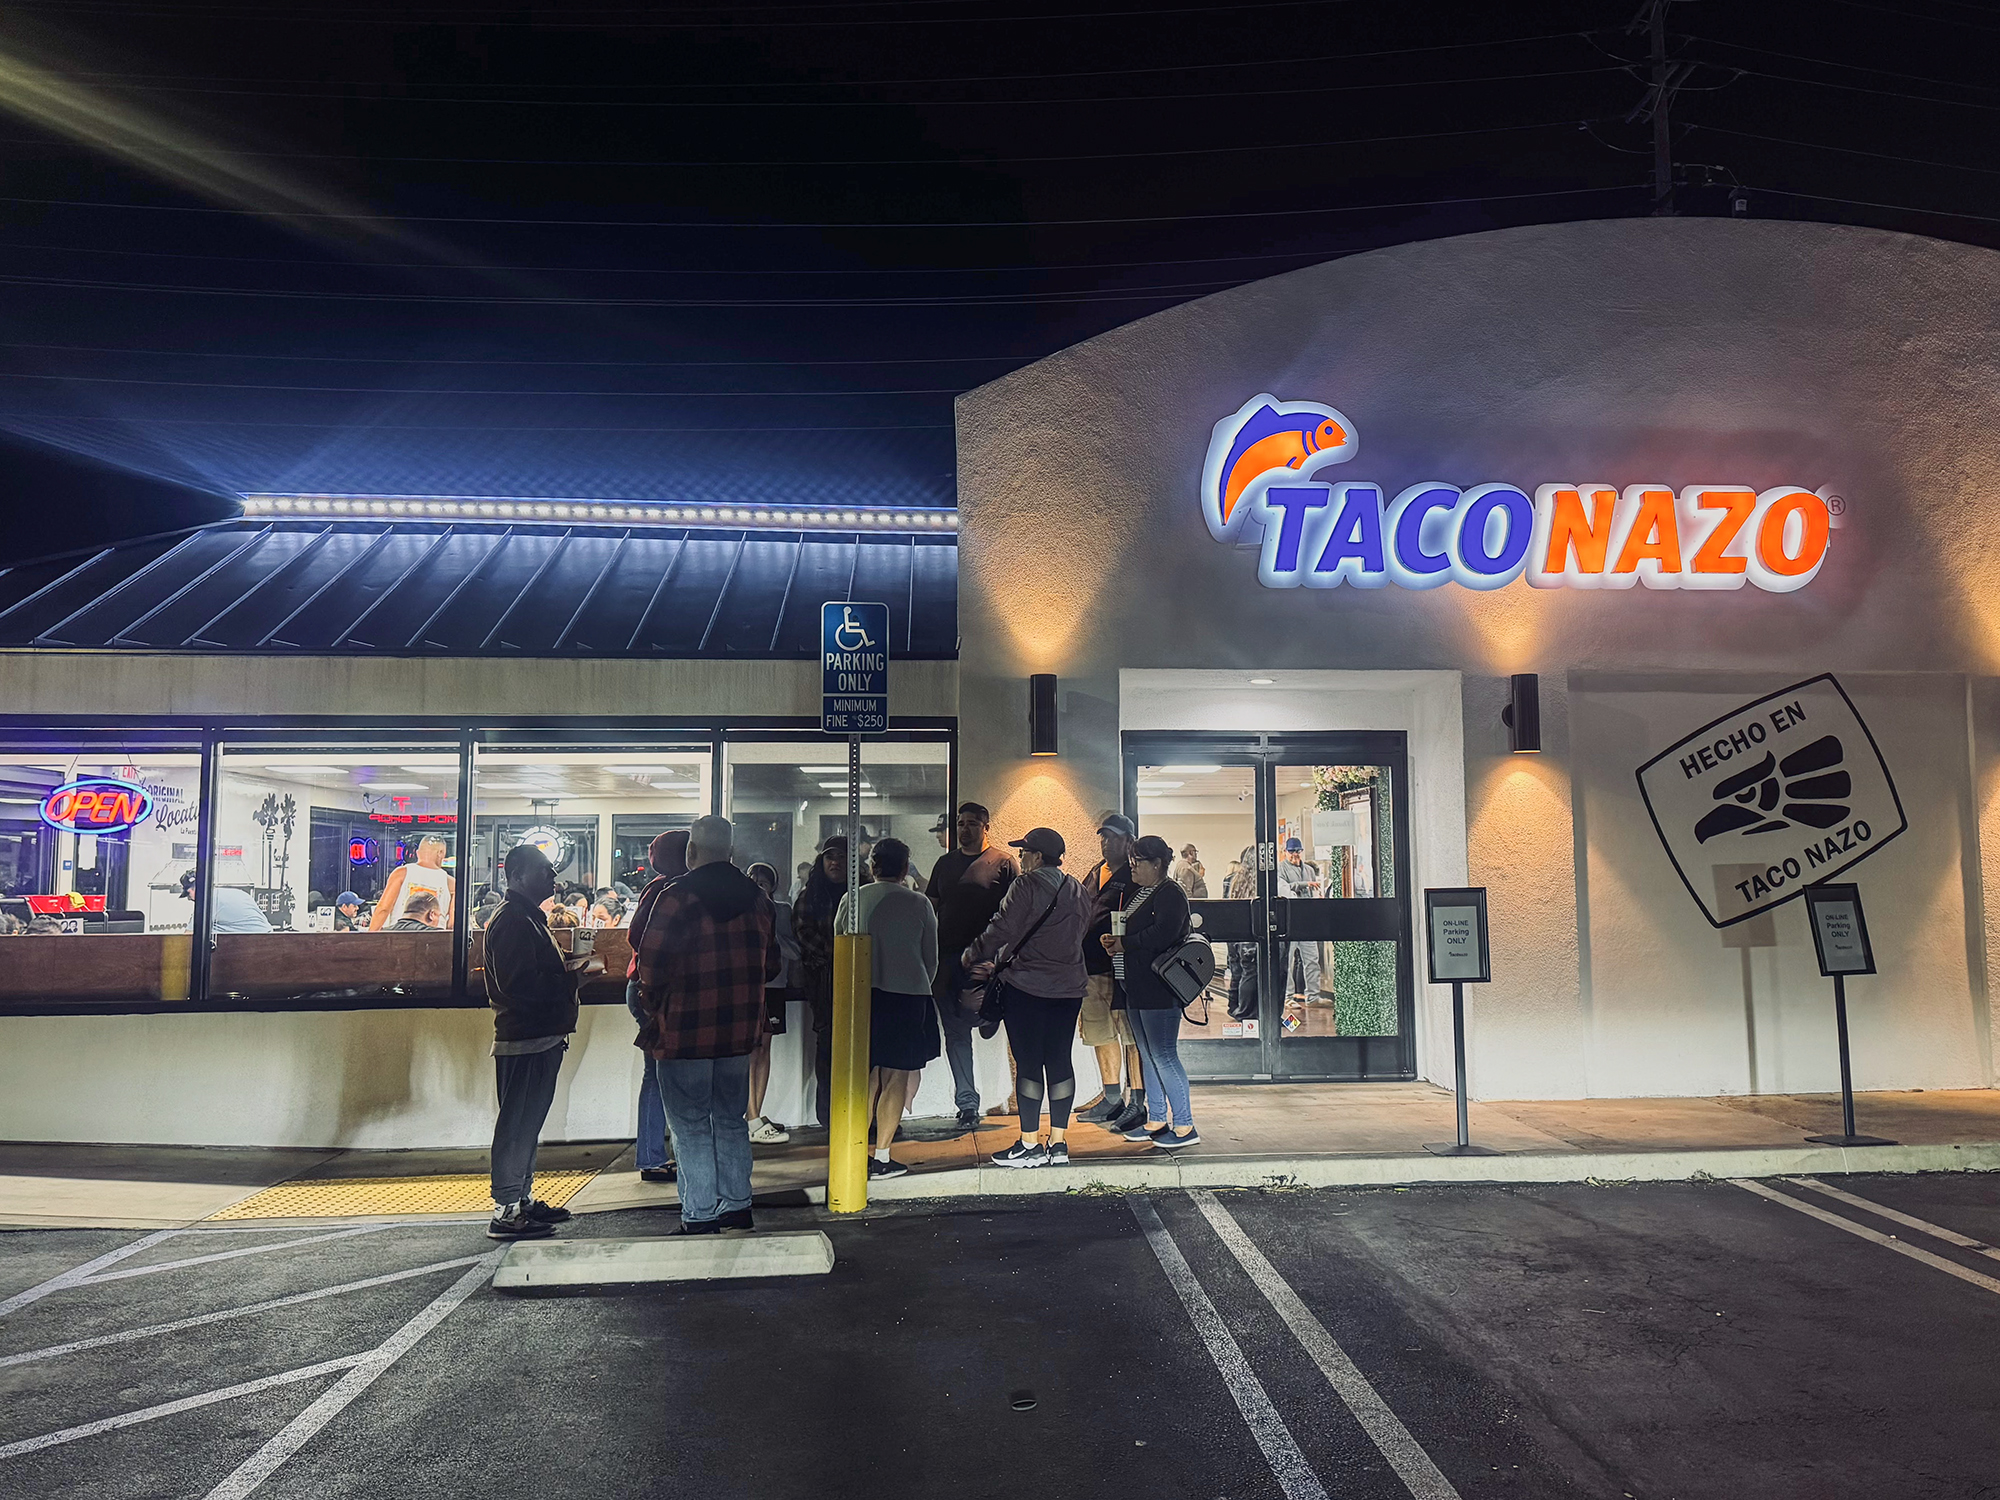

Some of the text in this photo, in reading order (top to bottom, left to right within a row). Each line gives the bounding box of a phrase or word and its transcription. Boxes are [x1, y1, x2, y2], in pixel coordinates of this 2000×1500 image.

[826, 653, 885, 671] PARKING
[838, 673, 872, 691] ONLY
[833, 699, 877, 712] MINIMUM
[826, 714, 884, 728] FINE $250
[1679, 700, 1807, 780] HECHO EN
[45, 790, 144, 824] OPEN
[156, 803, 199, 832] Locati
[1734, 820, 1872, 903] TACO NAZO
[1443, 928, 1470, 936] Parking
[1827, 922, 1851, 930] Parking
